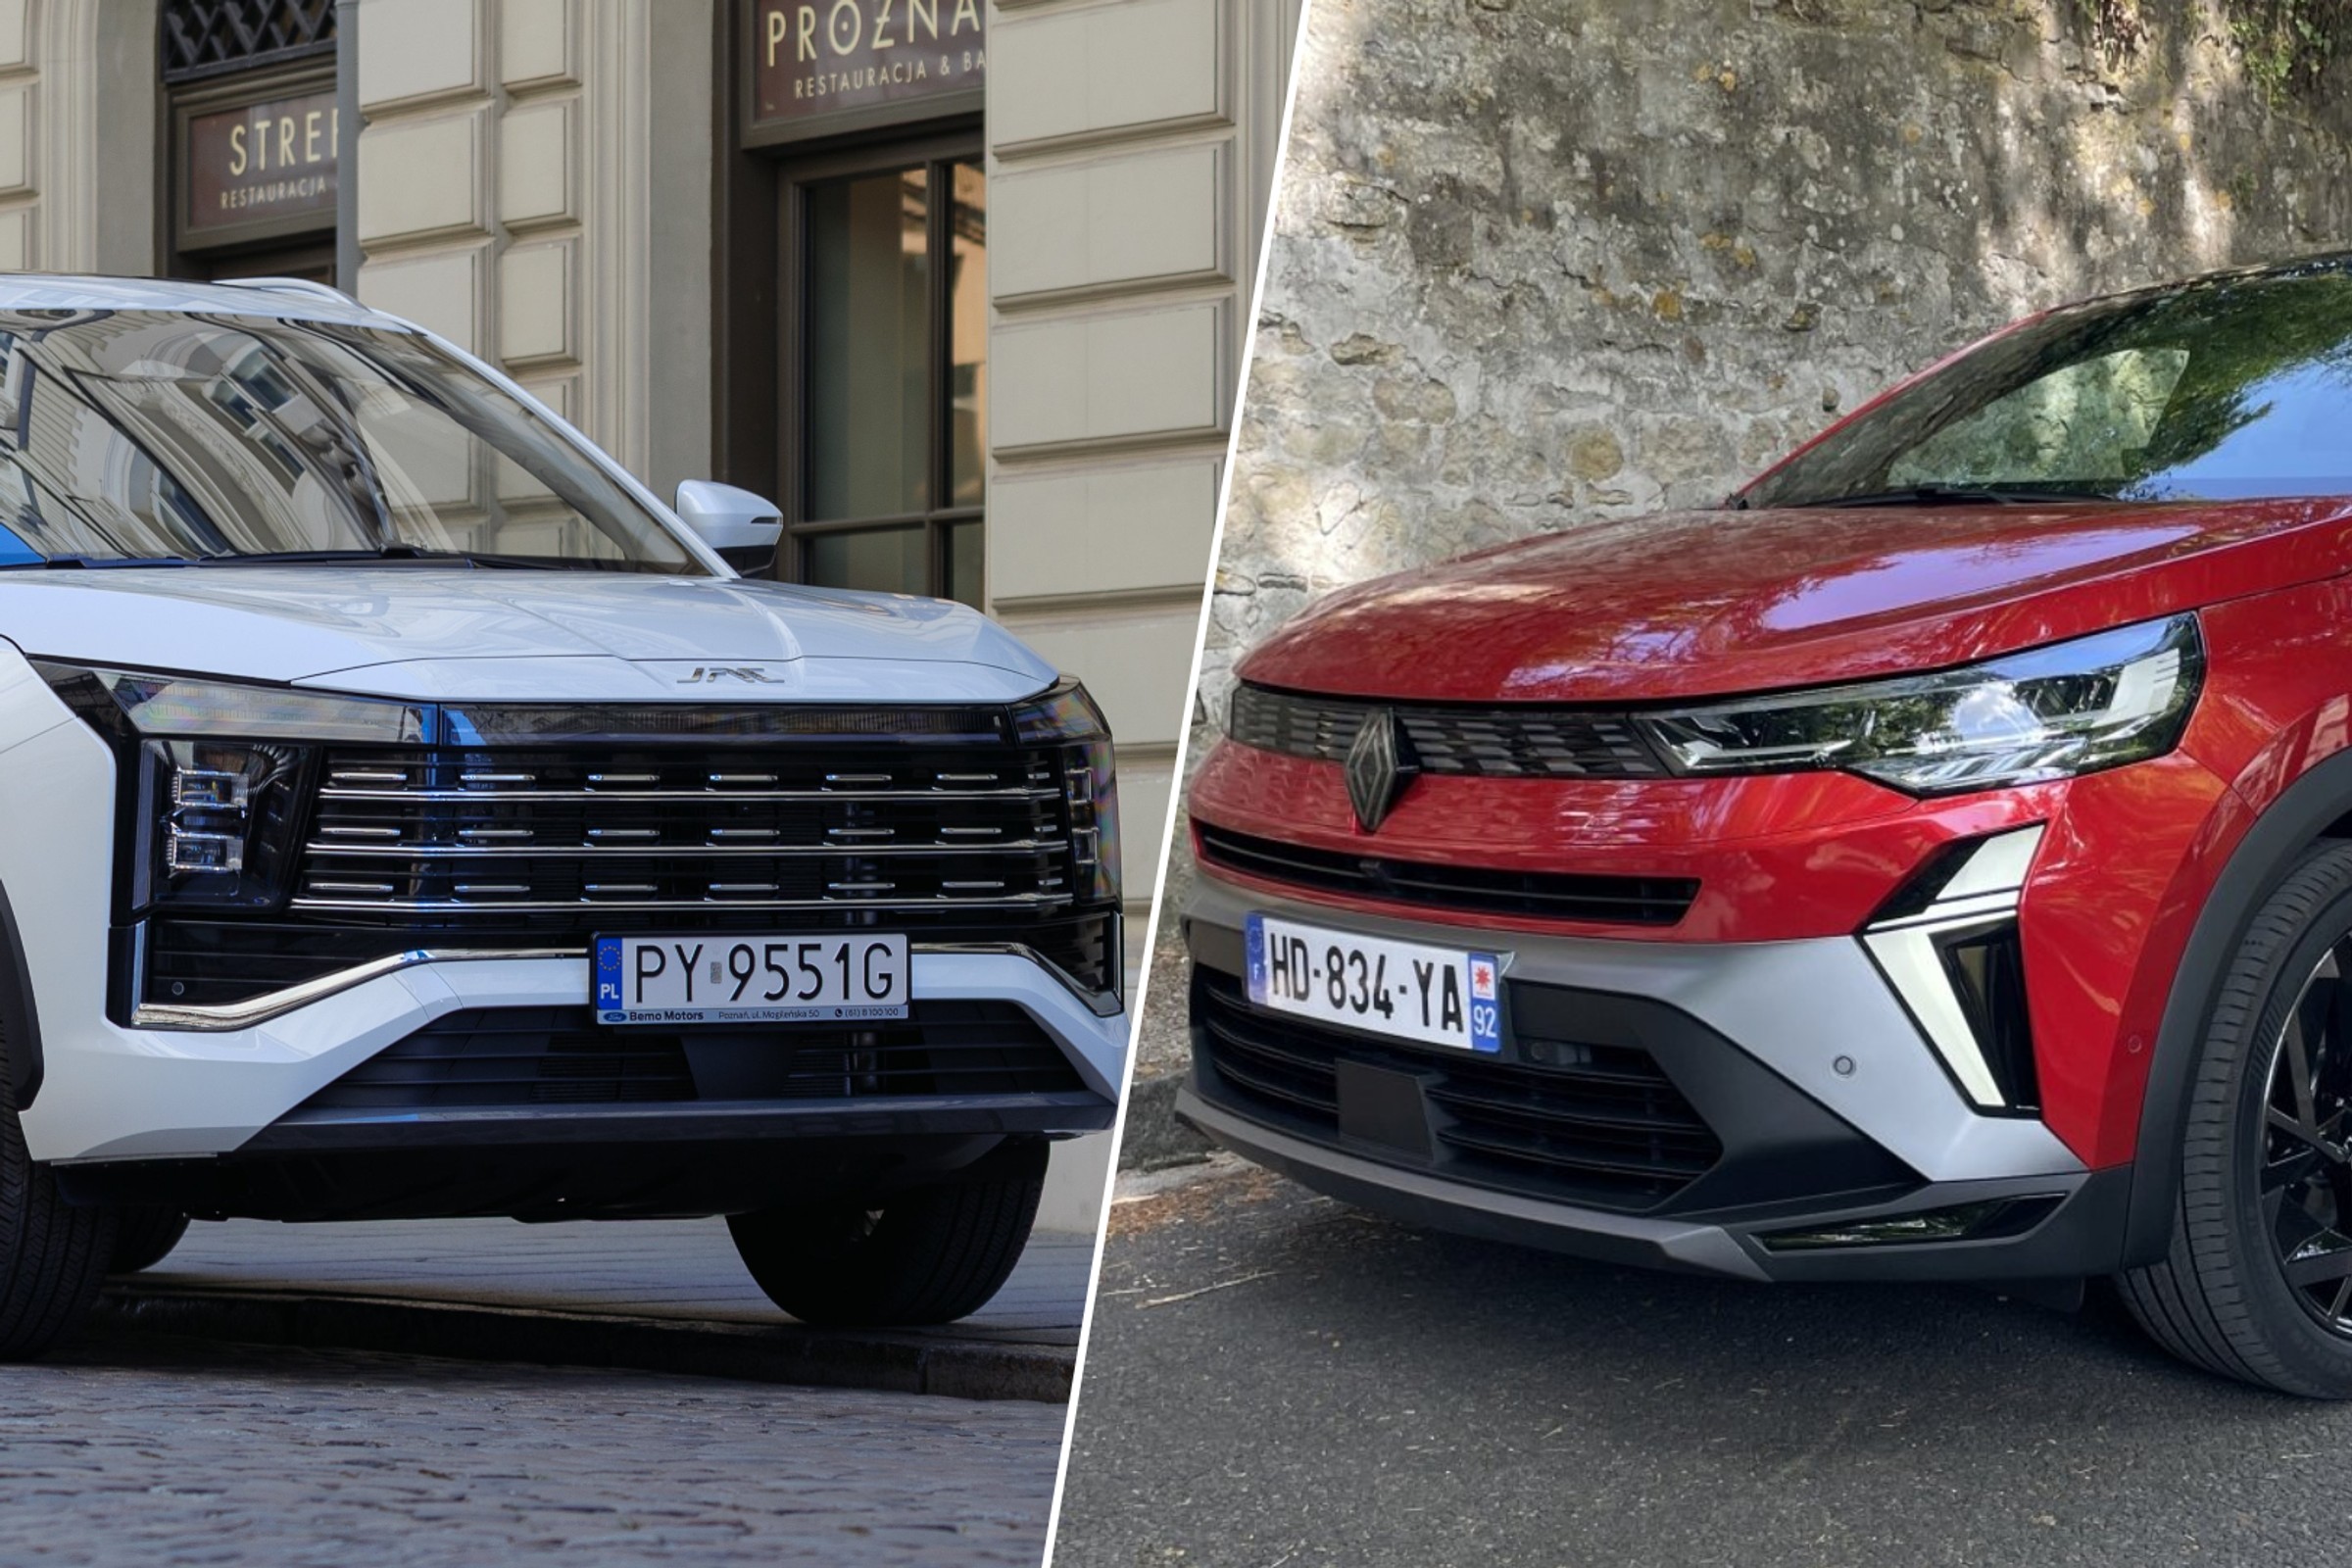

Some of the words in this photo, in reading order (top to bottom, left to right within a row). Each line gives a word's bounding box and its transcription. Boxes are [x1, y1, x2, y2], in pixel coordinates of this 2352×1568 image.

[795, 60, 927, 99] RESTAURACJA
[940, 55, 951, 75] &
[220, 175, 326, 210] RESTAURACJA
[636, 944, 704, 1003] PY
[728, 943, 893, 1002] 9551G
[1270, 932, 1463, 1033] HD-834-YA
[600, 983, 619, 1000] PL
[629, 1011, 662, 1021] Bemo
[664, 1010, 704, 1020] Motors
[808, 1009, 819, 1018] 50
[845, 1007, 860, 1018] (61)
[1473, 1004, 1497, 1038] 92
